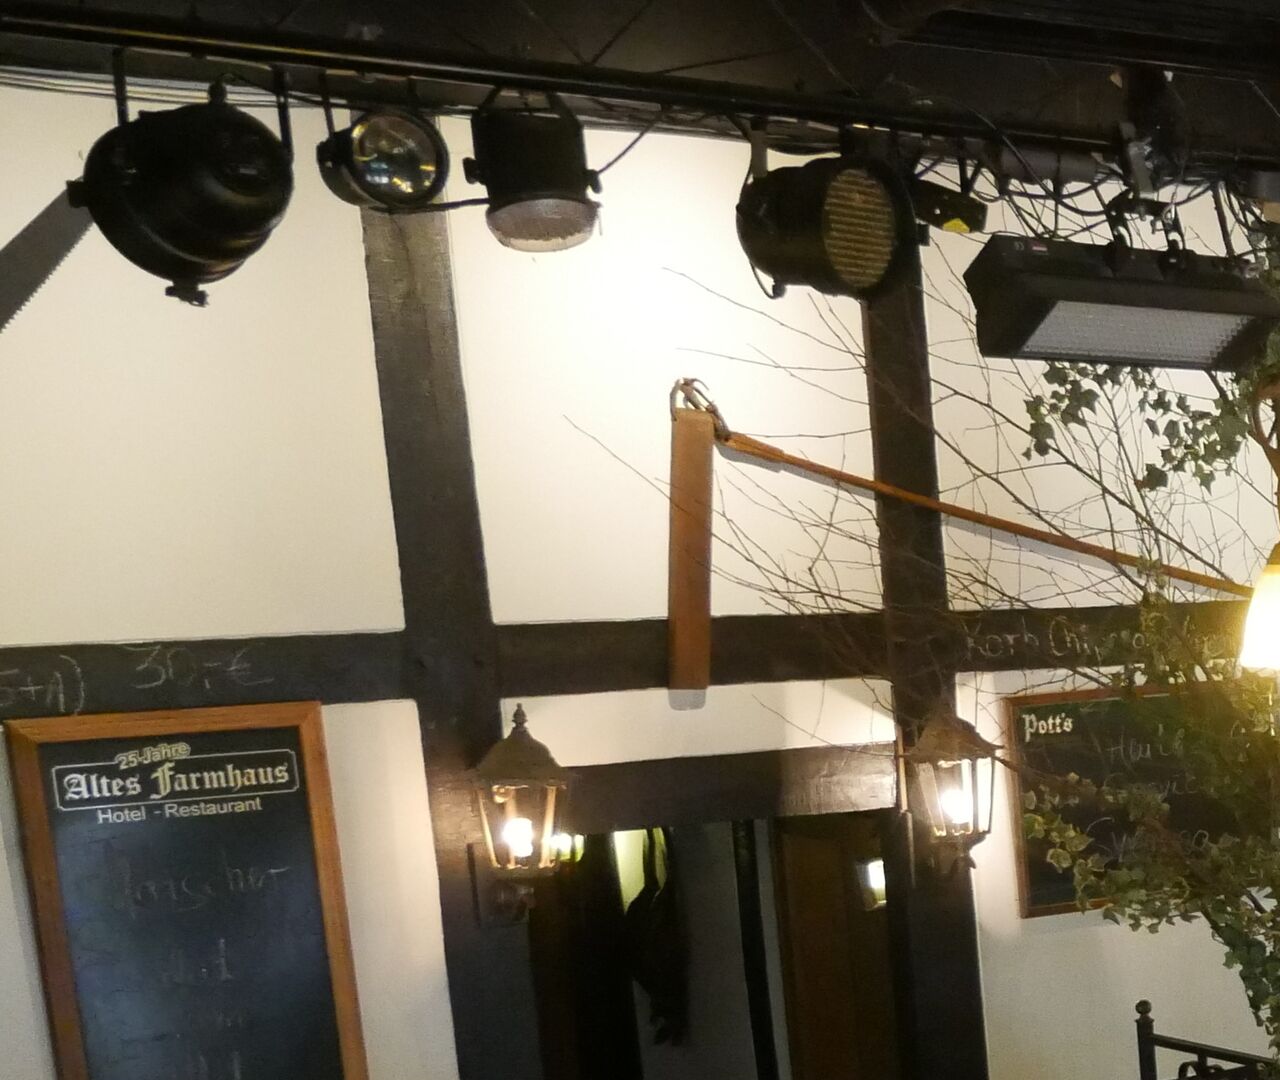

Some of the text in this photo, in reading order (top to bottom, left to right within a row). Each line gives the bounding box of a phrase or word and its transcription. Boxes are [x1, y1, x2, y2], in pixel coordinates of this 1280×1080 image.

[1022, 711, 1073, 743] Pott's
[118, 742, 190, 770] 25-Jahre
[63, 761, 290, 801] Altes Farmhaus
[97, 806, 146, 824] Hotel
[165, 797, 262, 818] Restaurant
